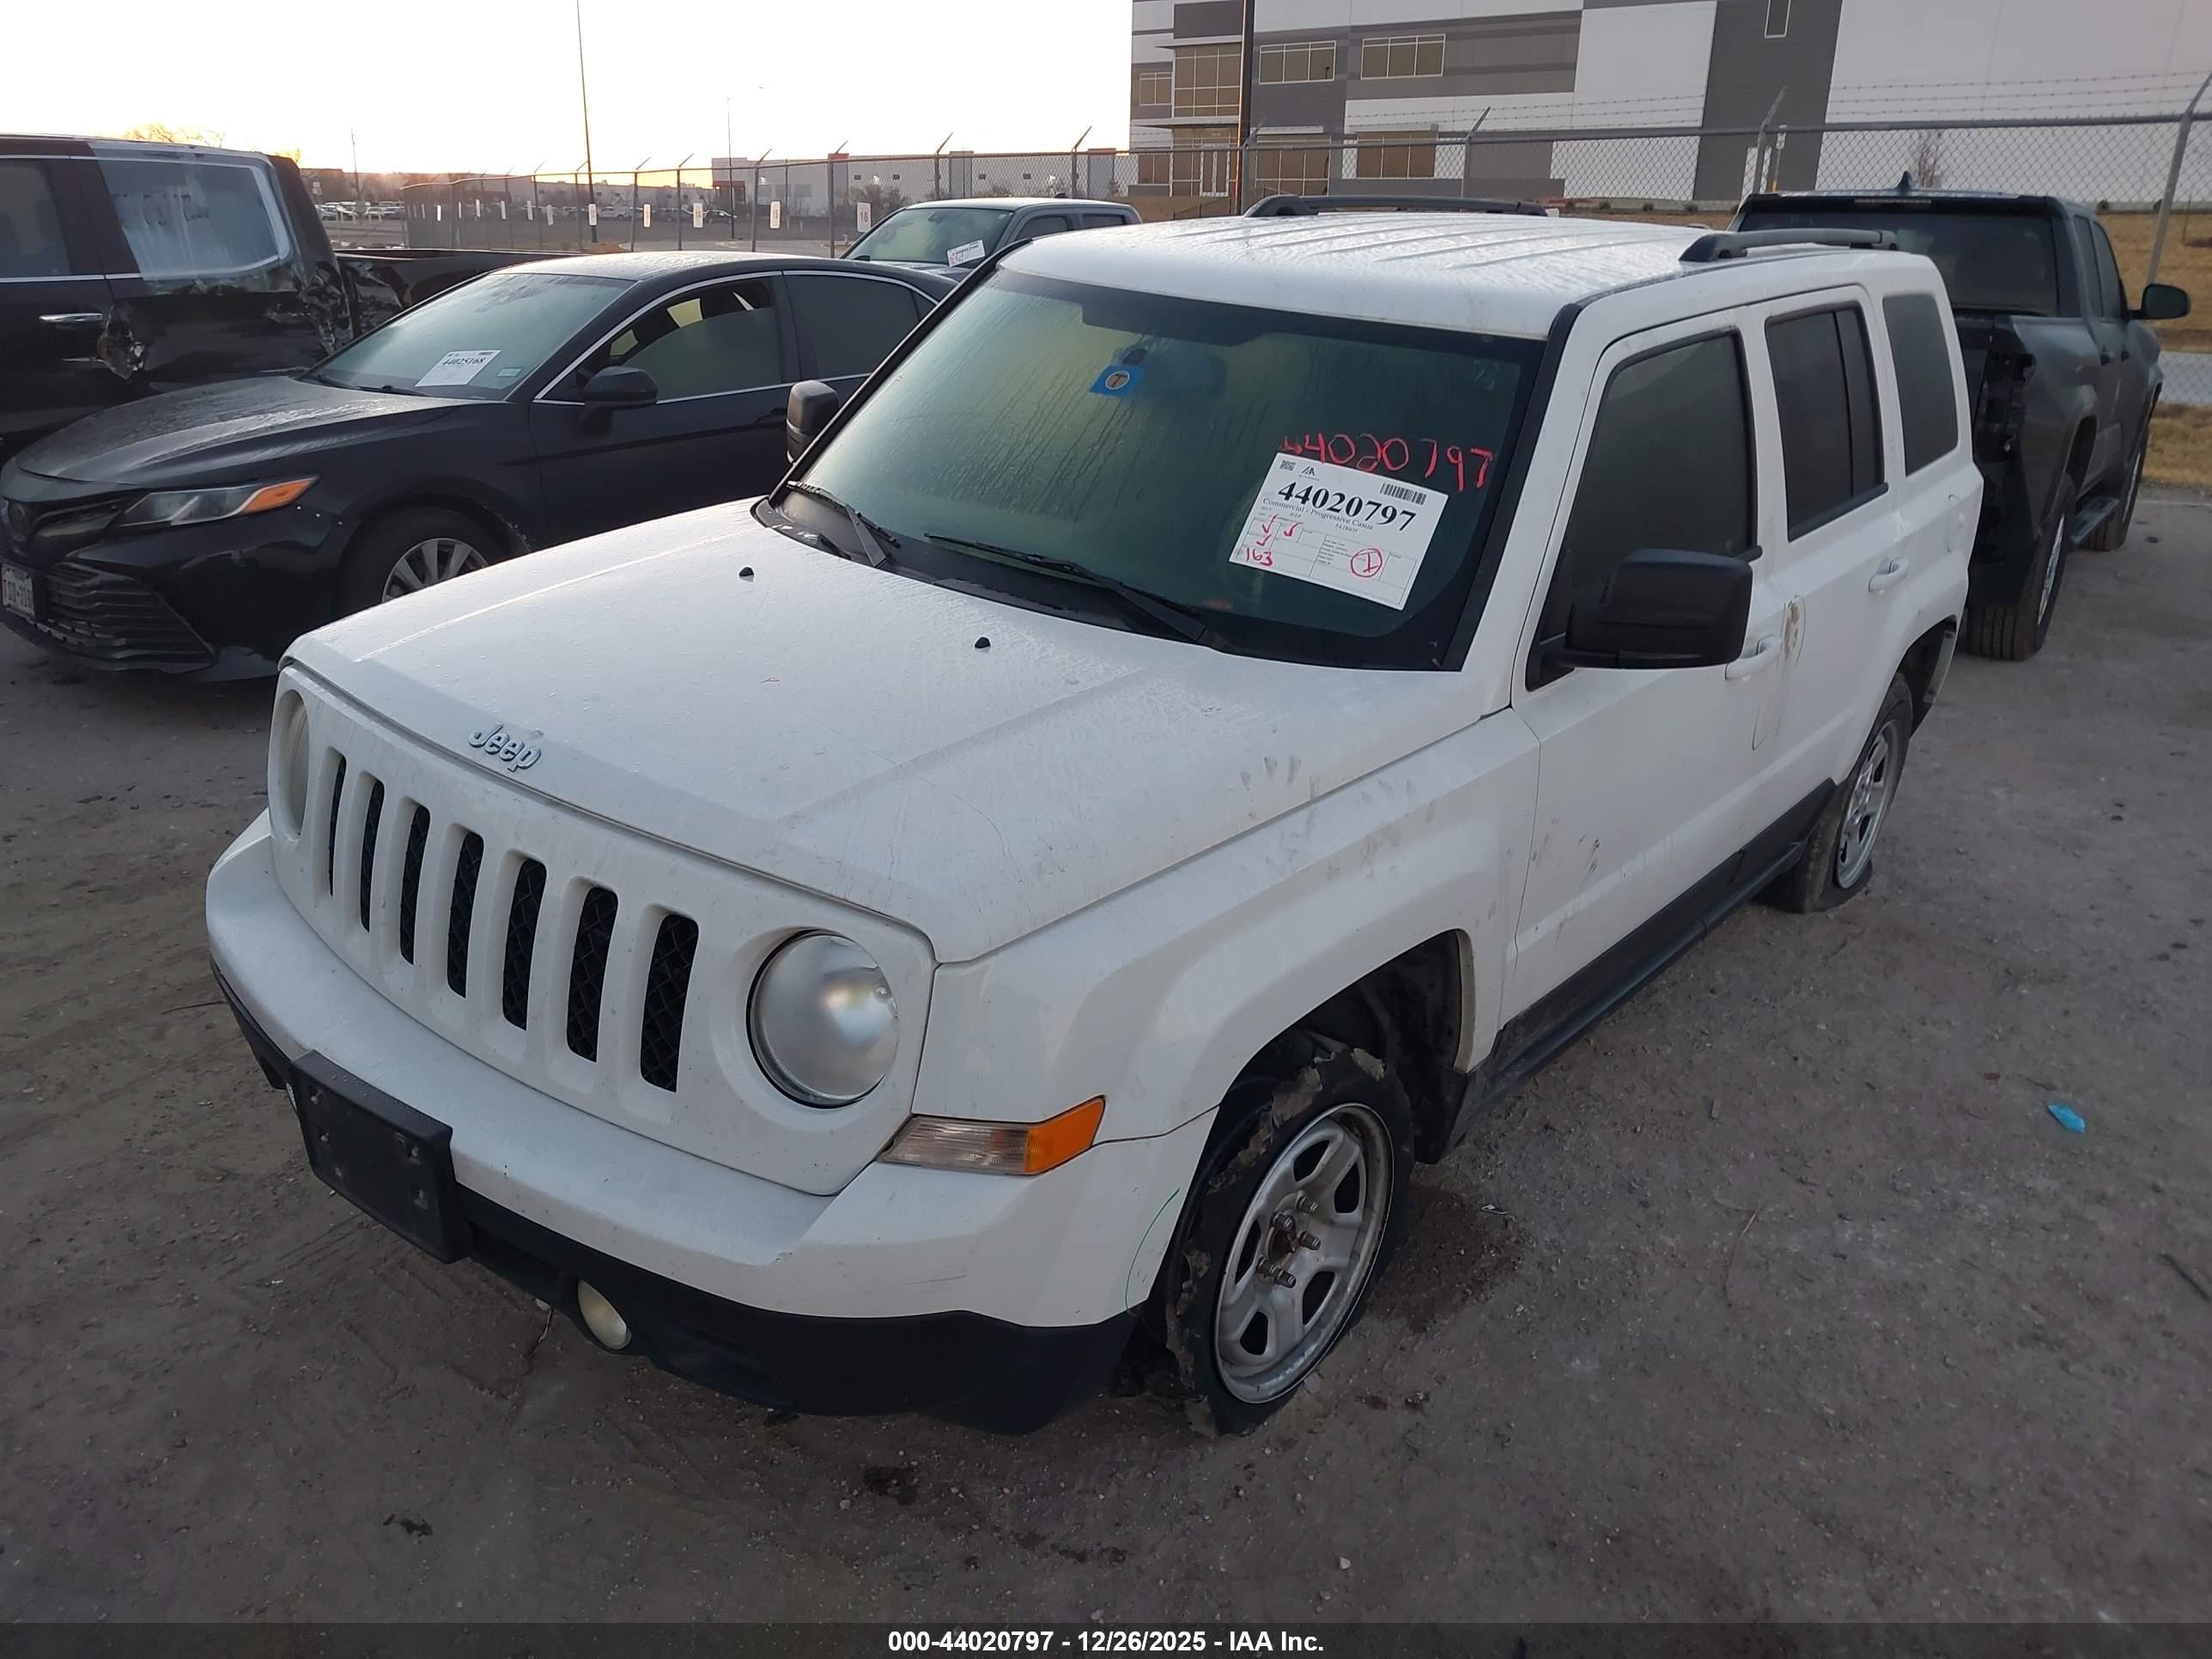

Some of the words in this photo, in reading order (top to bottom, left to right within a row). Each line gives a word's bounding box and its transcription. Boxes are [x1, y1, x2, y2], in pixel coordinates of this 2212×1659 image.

[860, 211, 869, 222] 16
[1279, 433, 1494, 493] 44020797
[1262, 497, 1305, 513] Commercial
[1310, 508, 1351, 524] Progressive
[1278, 481, 1417, 532] 44020797
[468, 722, 542, 773] Jeep
